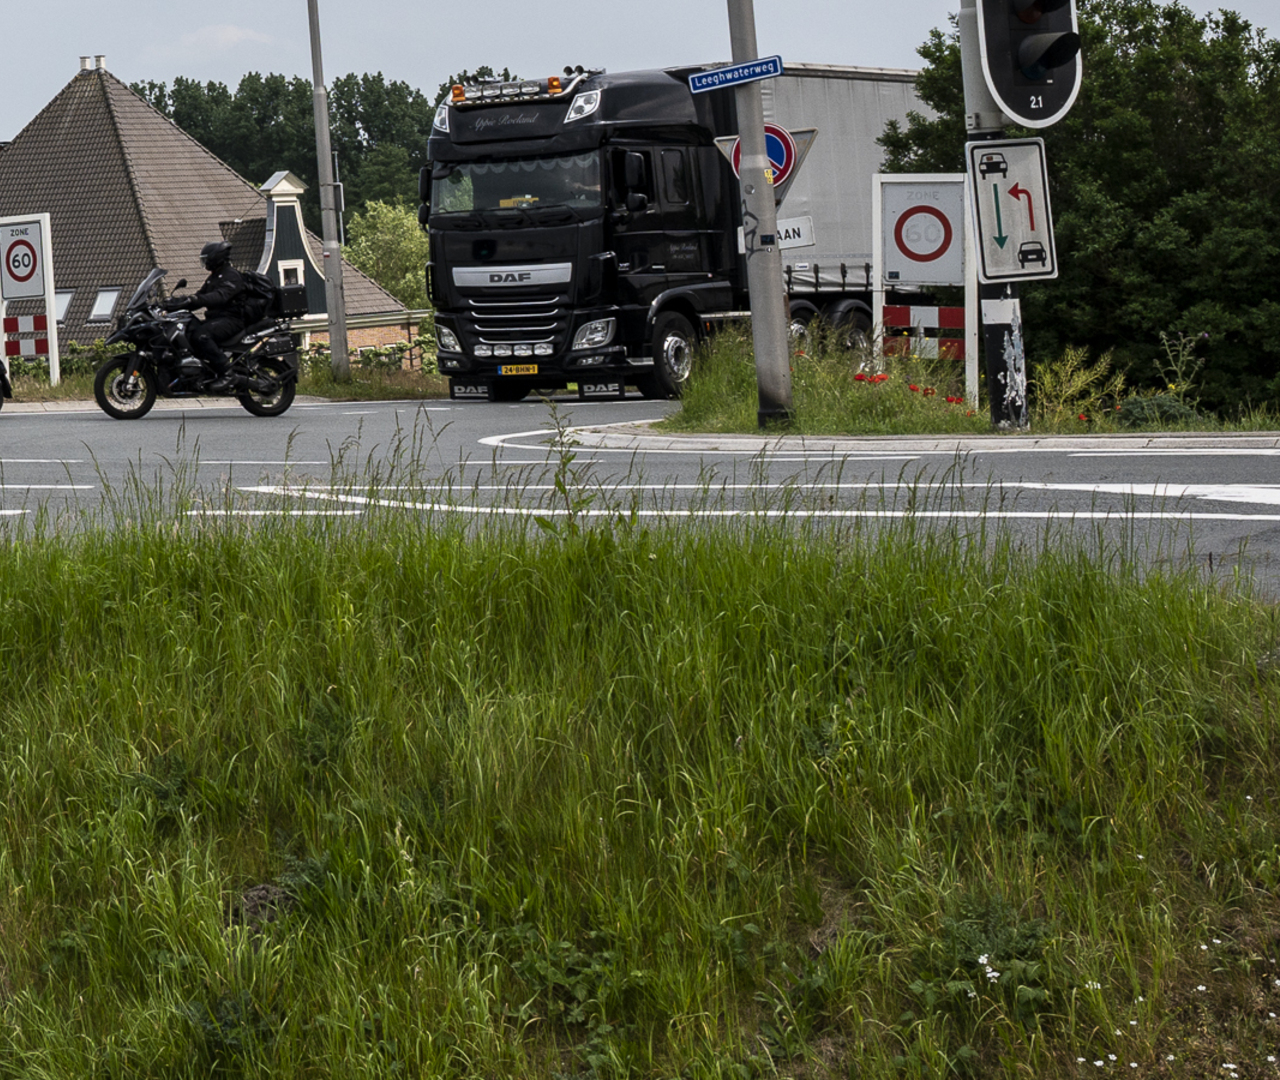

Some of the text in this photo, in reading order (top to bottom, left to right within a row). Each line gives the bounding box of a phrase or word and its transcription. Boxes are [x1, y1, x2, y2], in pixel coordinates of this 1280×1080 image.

[694, 62, 775, 87] Leeghwaterweg
[906, 190, 940, 201] ZONE
[10, 227, 30, 237] ZONE
[905, 223, 941, 244] 60
[11, 252, 32, 269] 60
[488, 272, 532, 283] DAF
[453, 385, 489, 393] DAF
[583, 383, 620, 392] DAF
